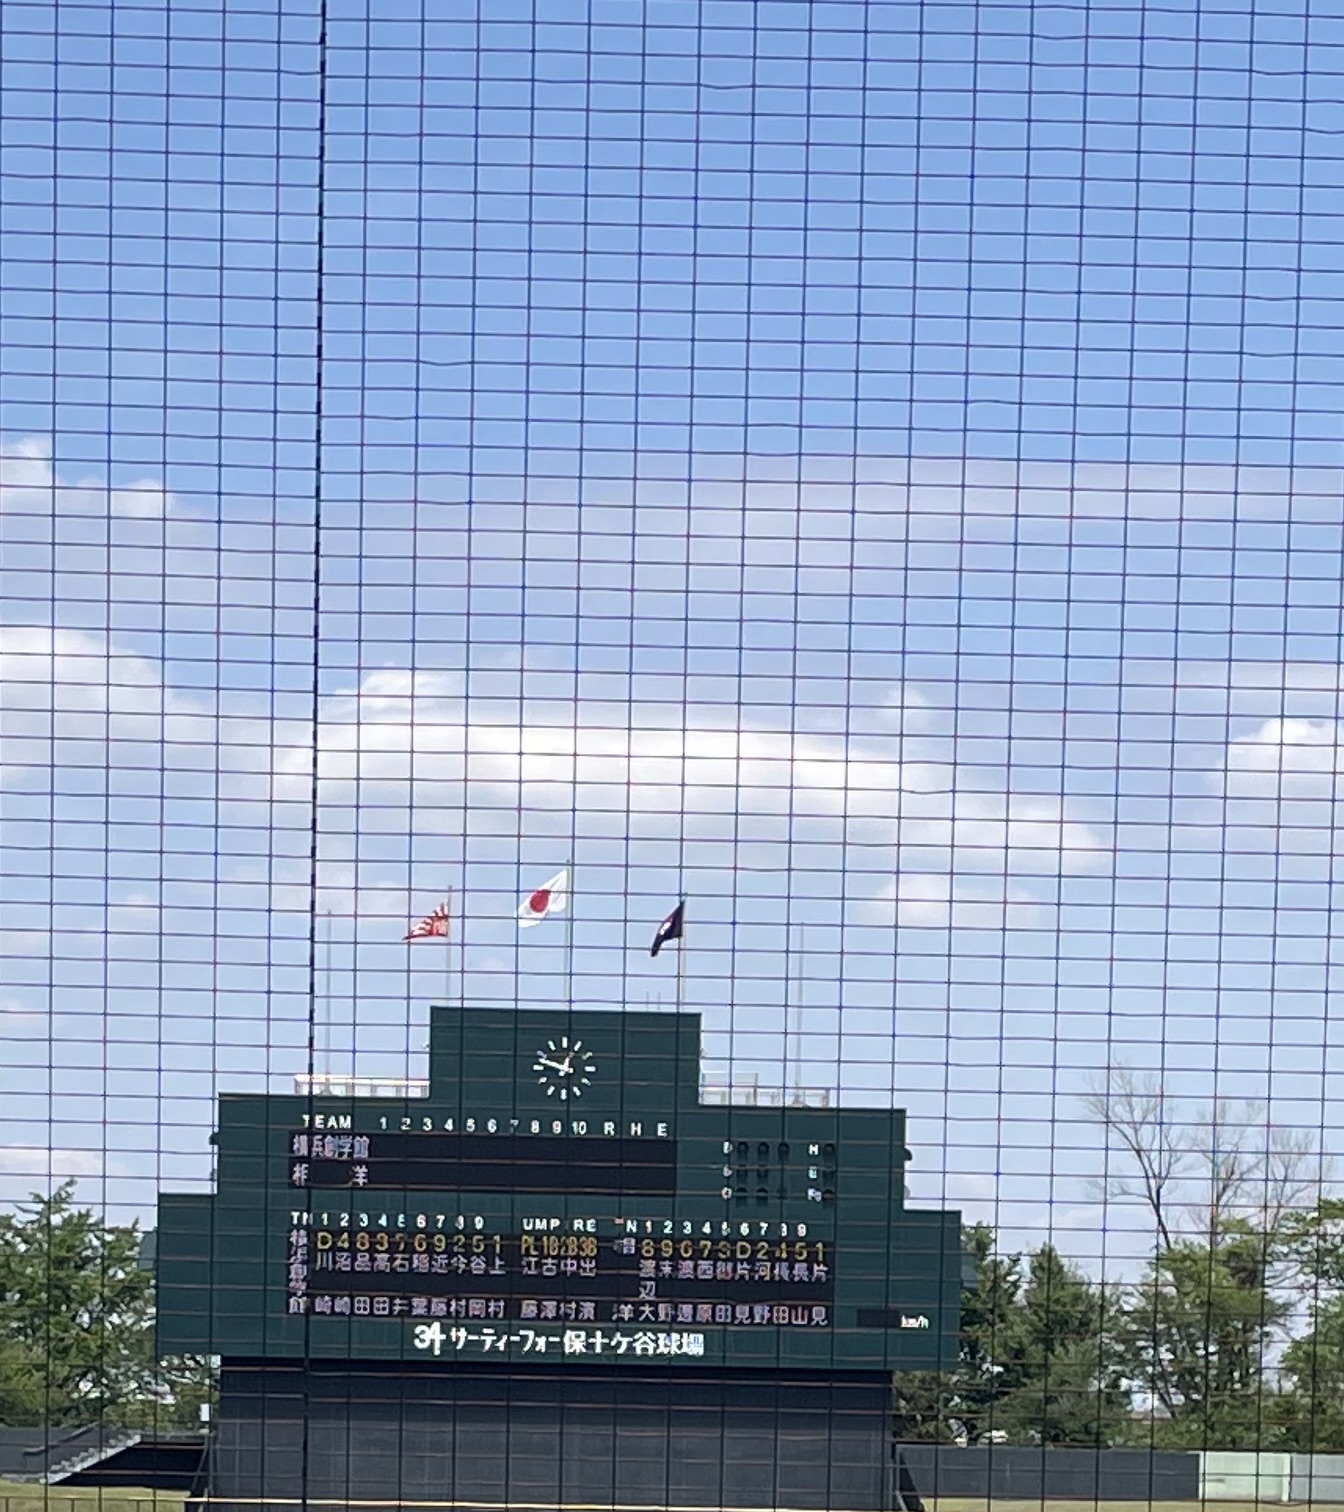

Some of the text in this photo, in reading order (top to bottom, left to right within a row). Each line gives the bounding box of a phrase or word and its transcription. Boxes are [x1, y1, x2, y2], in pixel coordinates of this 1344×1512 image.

[302, 1114, 351, 1129] TEAM
[379, 1117, 387, 1130] 1
[401, 1117, 411, 1131] 2
[422, 1117, 433, 1132] 3
[444, 1118, 454, 1132] 4
[466, 1118, 476, 1133] 5
[487, 1118, 497, 1133] 6
[530, 1119, 540, 1134] 8
[551, 1120, 562, 1135] 9
[571, 1121, 587, 1136] 10
[604, 1121, 615, 1136] R
[630, 1122, 642, 1136] H
[657, 1122, 668, 1137] E
[808, 1143, 819, 1156] H
[321, 1212, 328, 1226] 1
[340, 1212, 350, 1227] 2
[359, 1213, 369, 1228] 3
[378, 1213, 388, 1228] 4
[416, 1214, 427, 1229] 6
[436, 1214, 446, 1229] 7
[474, 1215, 484, 1230] 9
[522, 1218, 597, 1232] UMPRE
[645, 1220, 652, 1233] 1
[663, 1220, 673, 1234] 2
[682, 1220, 692, 1235] 3
[701, 1221, 712, 1235] 4
[740, 1222, 750, 1237] 6
[759, 1221, 769, 1236] 7
[797, 1223, 807, 1237] 9
[317, 1231, 333, 1250] D
[336, 1231, 350, 1250] 4
[356, 1232, 370, 1251] 8
[375, 1232, 389, 1251] 3
[414, 1233, 427, 1252] 6
[433, 1234, 446, 1253] 9
[453, 1234, 466, 1253] 2
[472, 1235, 485, 1253] 5
[493, 1234, 501, 1255] 1
[641, 1239, 654, 1257] 8
[660, 1239, 674, 1258] 9
[680, 1240, 693, 1258] 6
[699, 1240, 712, 1258] 7
[736, 1241, 751, 1260] D
[756, 1241, 770, 1260] 2
[794, 1242, 808, 1261] 5
[815, 1241, 824, 1262] 1
